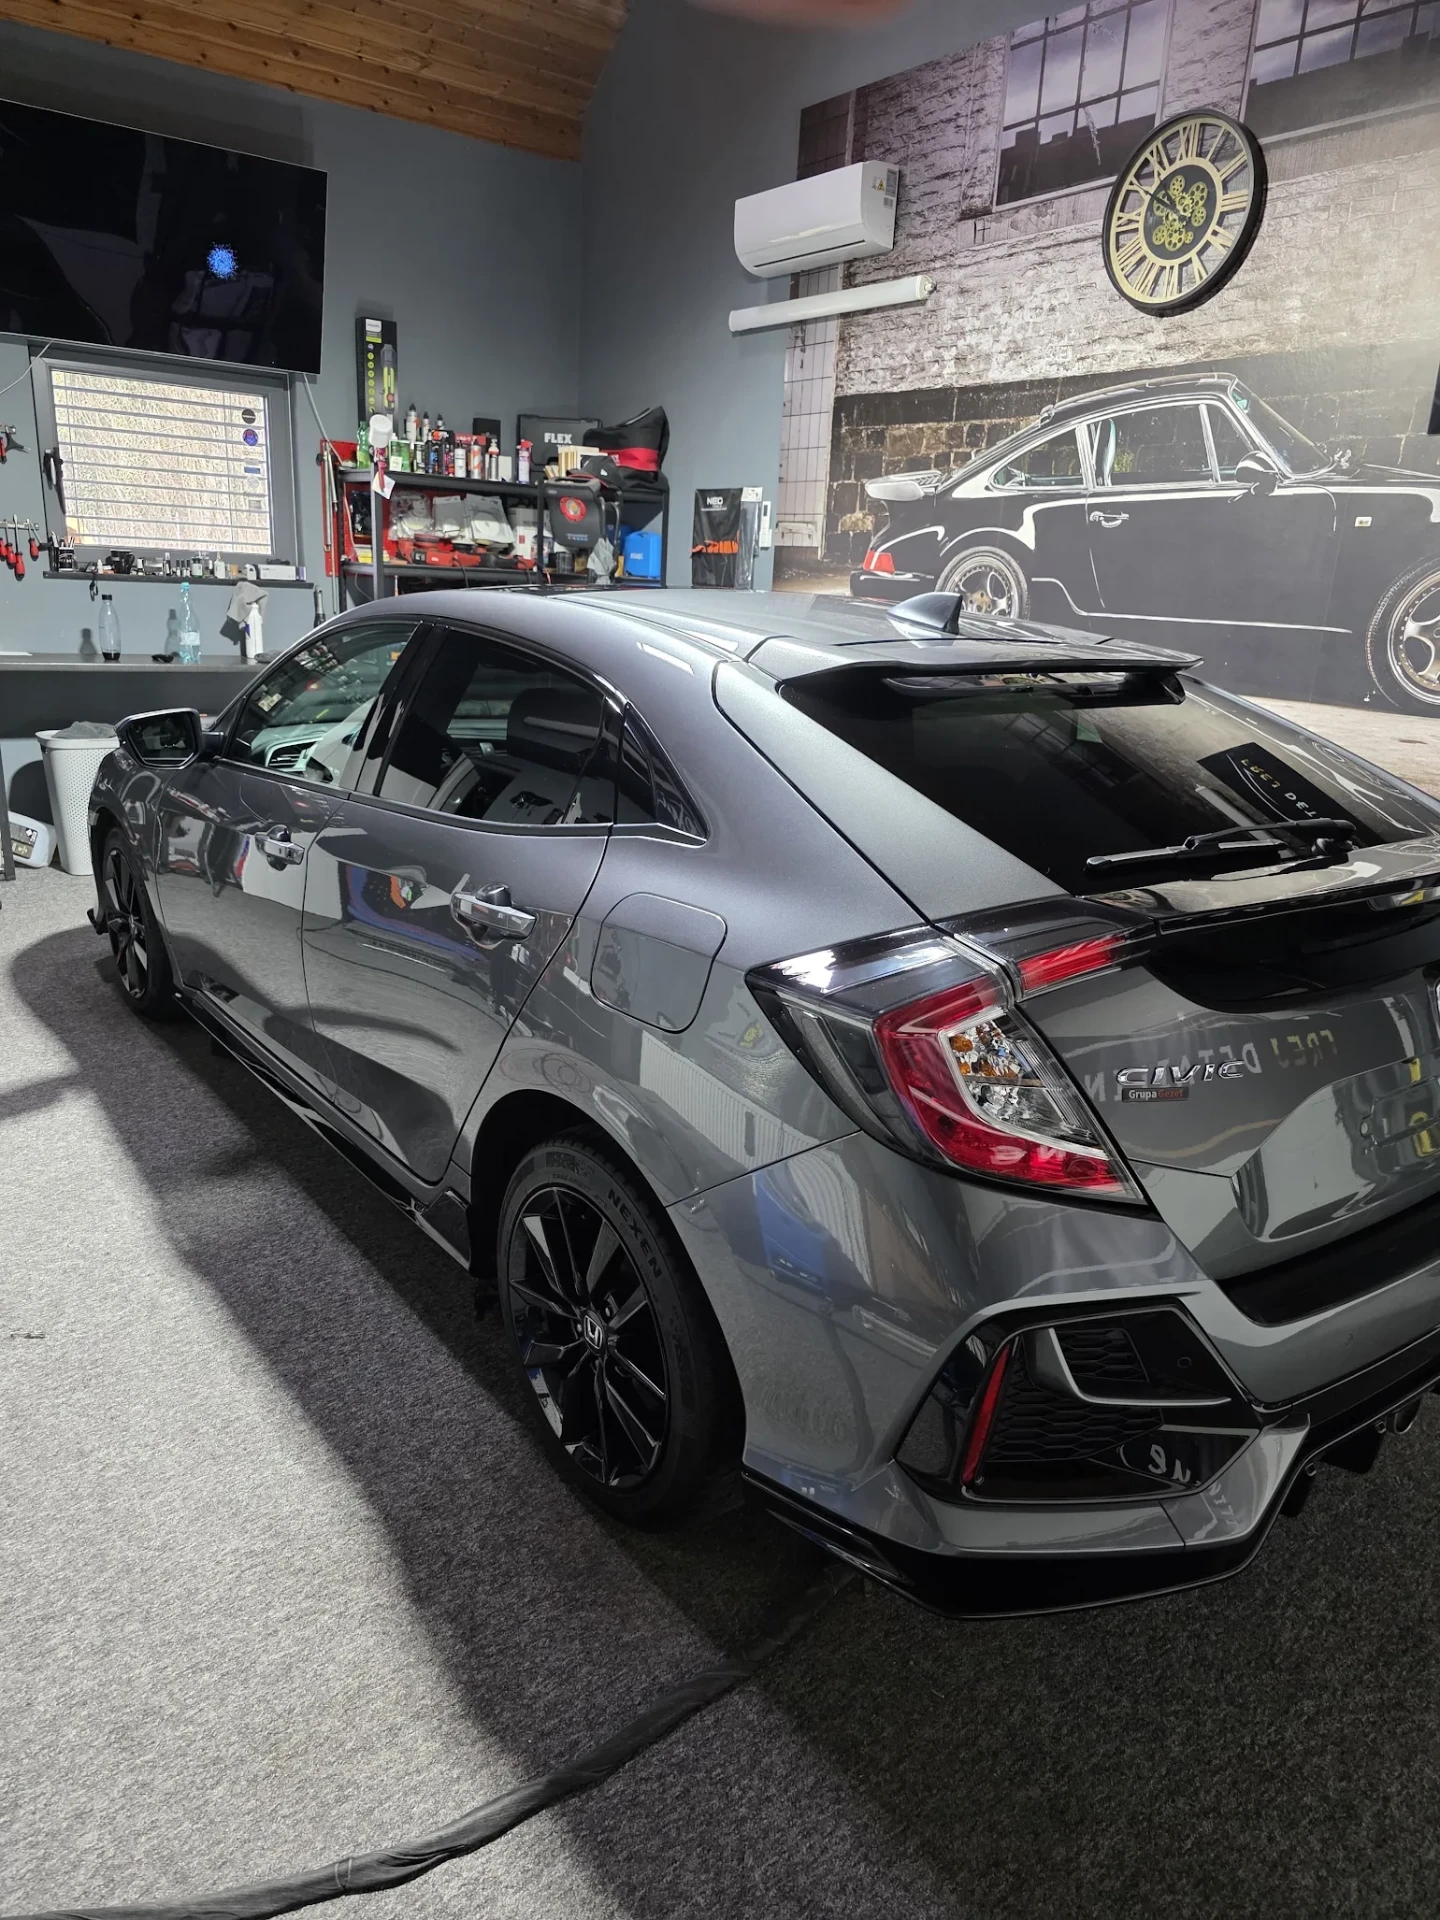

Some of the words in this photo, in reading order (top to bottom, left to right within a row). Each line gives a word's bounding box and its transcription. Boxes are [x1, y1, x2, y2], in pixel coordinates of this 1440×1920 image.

[544, 432, 572, 444] FLEX
[706, 496, 723, 505] NEO
[1116, 1060, 1246, 1086] CIVIC
[1128, 1089, 1157, 1101] Grupa
[1158, 1088, 1184, 1099] Gezet
[607, 1188, 661, 1280] NEXEN
